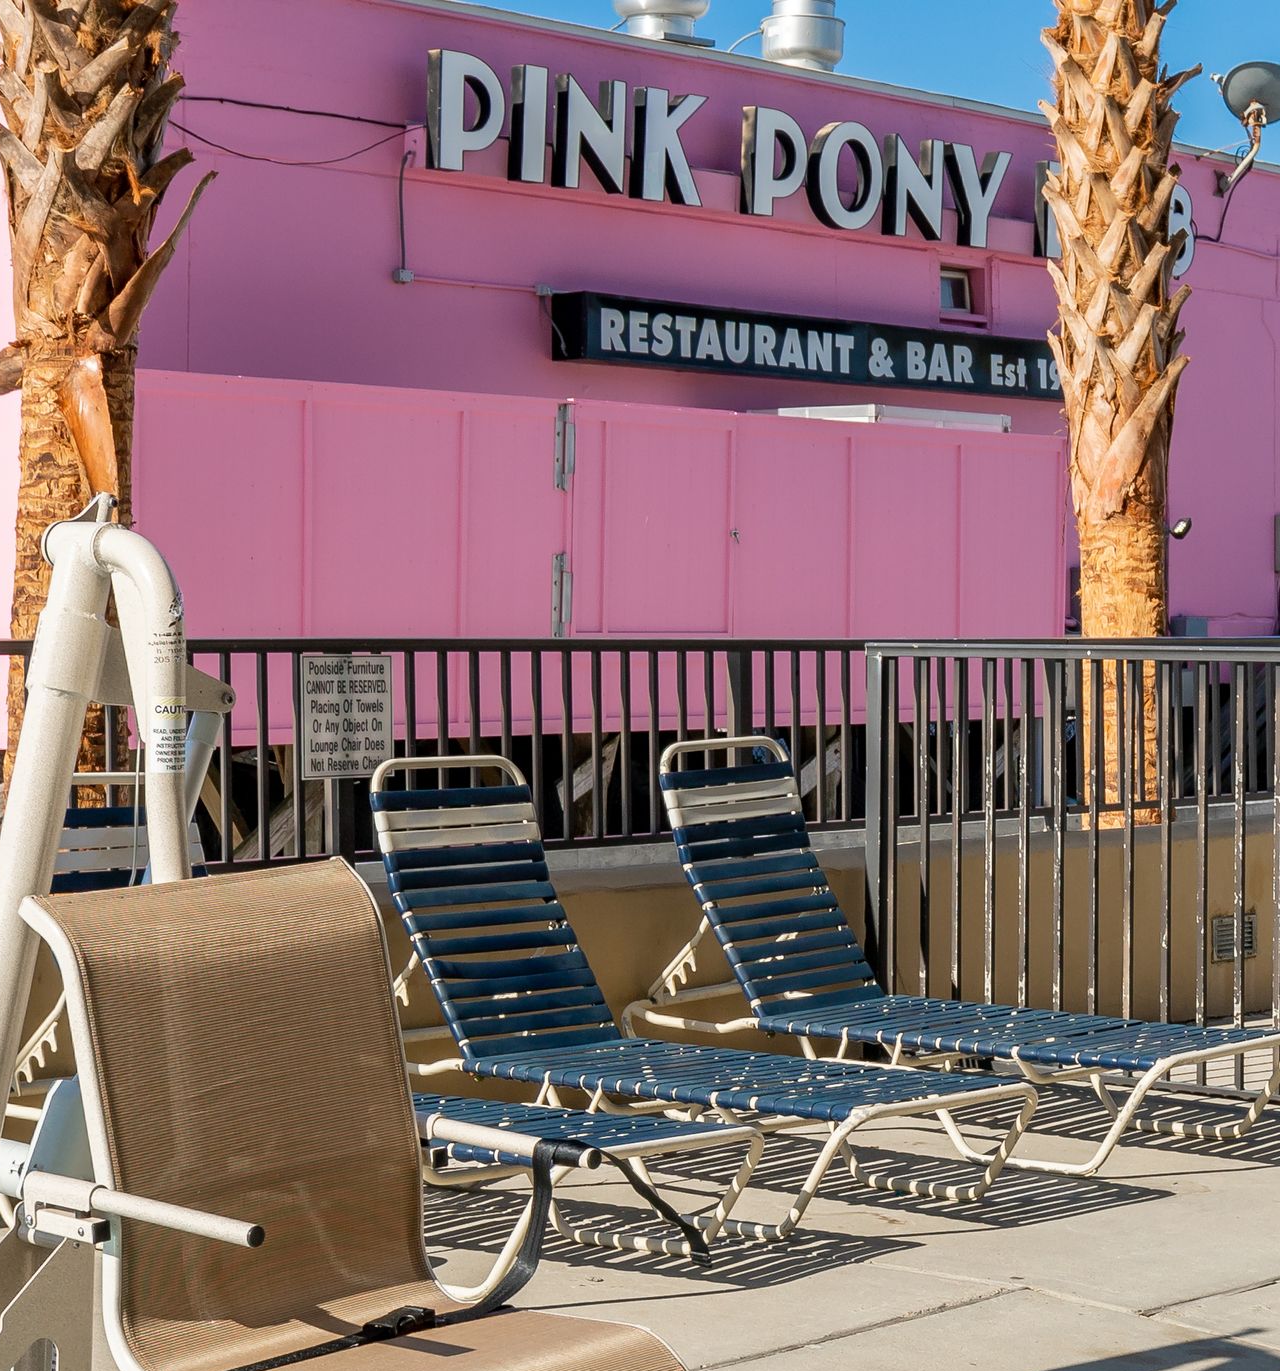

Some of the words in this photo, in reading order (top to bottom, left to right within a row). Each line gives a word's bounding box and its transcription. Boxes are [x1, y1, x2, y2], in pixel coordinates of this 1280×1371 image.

[428, 48, 708, 208] PINK
[740, 105, 1013, 249] PONY
[600, 307, 855, 375] RESTAURANT
[868, 338, 895, 378] &
[907, 340, 974, 384] BAR
[990, 353, 1027, 388] Est
[309, 661, 344, 676] Poolside
[347, 660, 384, 675] Furniture
[306, 680, 335, 695] CANNOT
[337, 680, 347, 694] BE
[349, 679, 388, 694] RESERVED.
[310, 700, 340, 716] Placing
[343, 699, 353, 713] Of
[356, 699, 384, 713] Towels
[312, 719, 322, 733] Or
[325, 719, 339, 735] Any
[342, 718, 369, 735] Object
[371, 718, 383, 732] On
[310, 739, 338, 755] Lounge
[341, 737, 362, 752] Chair
[364, 737, 385, 751] Does
[310, 758, 324, 772] Not
[327, 757, 359, 771] Reserve
